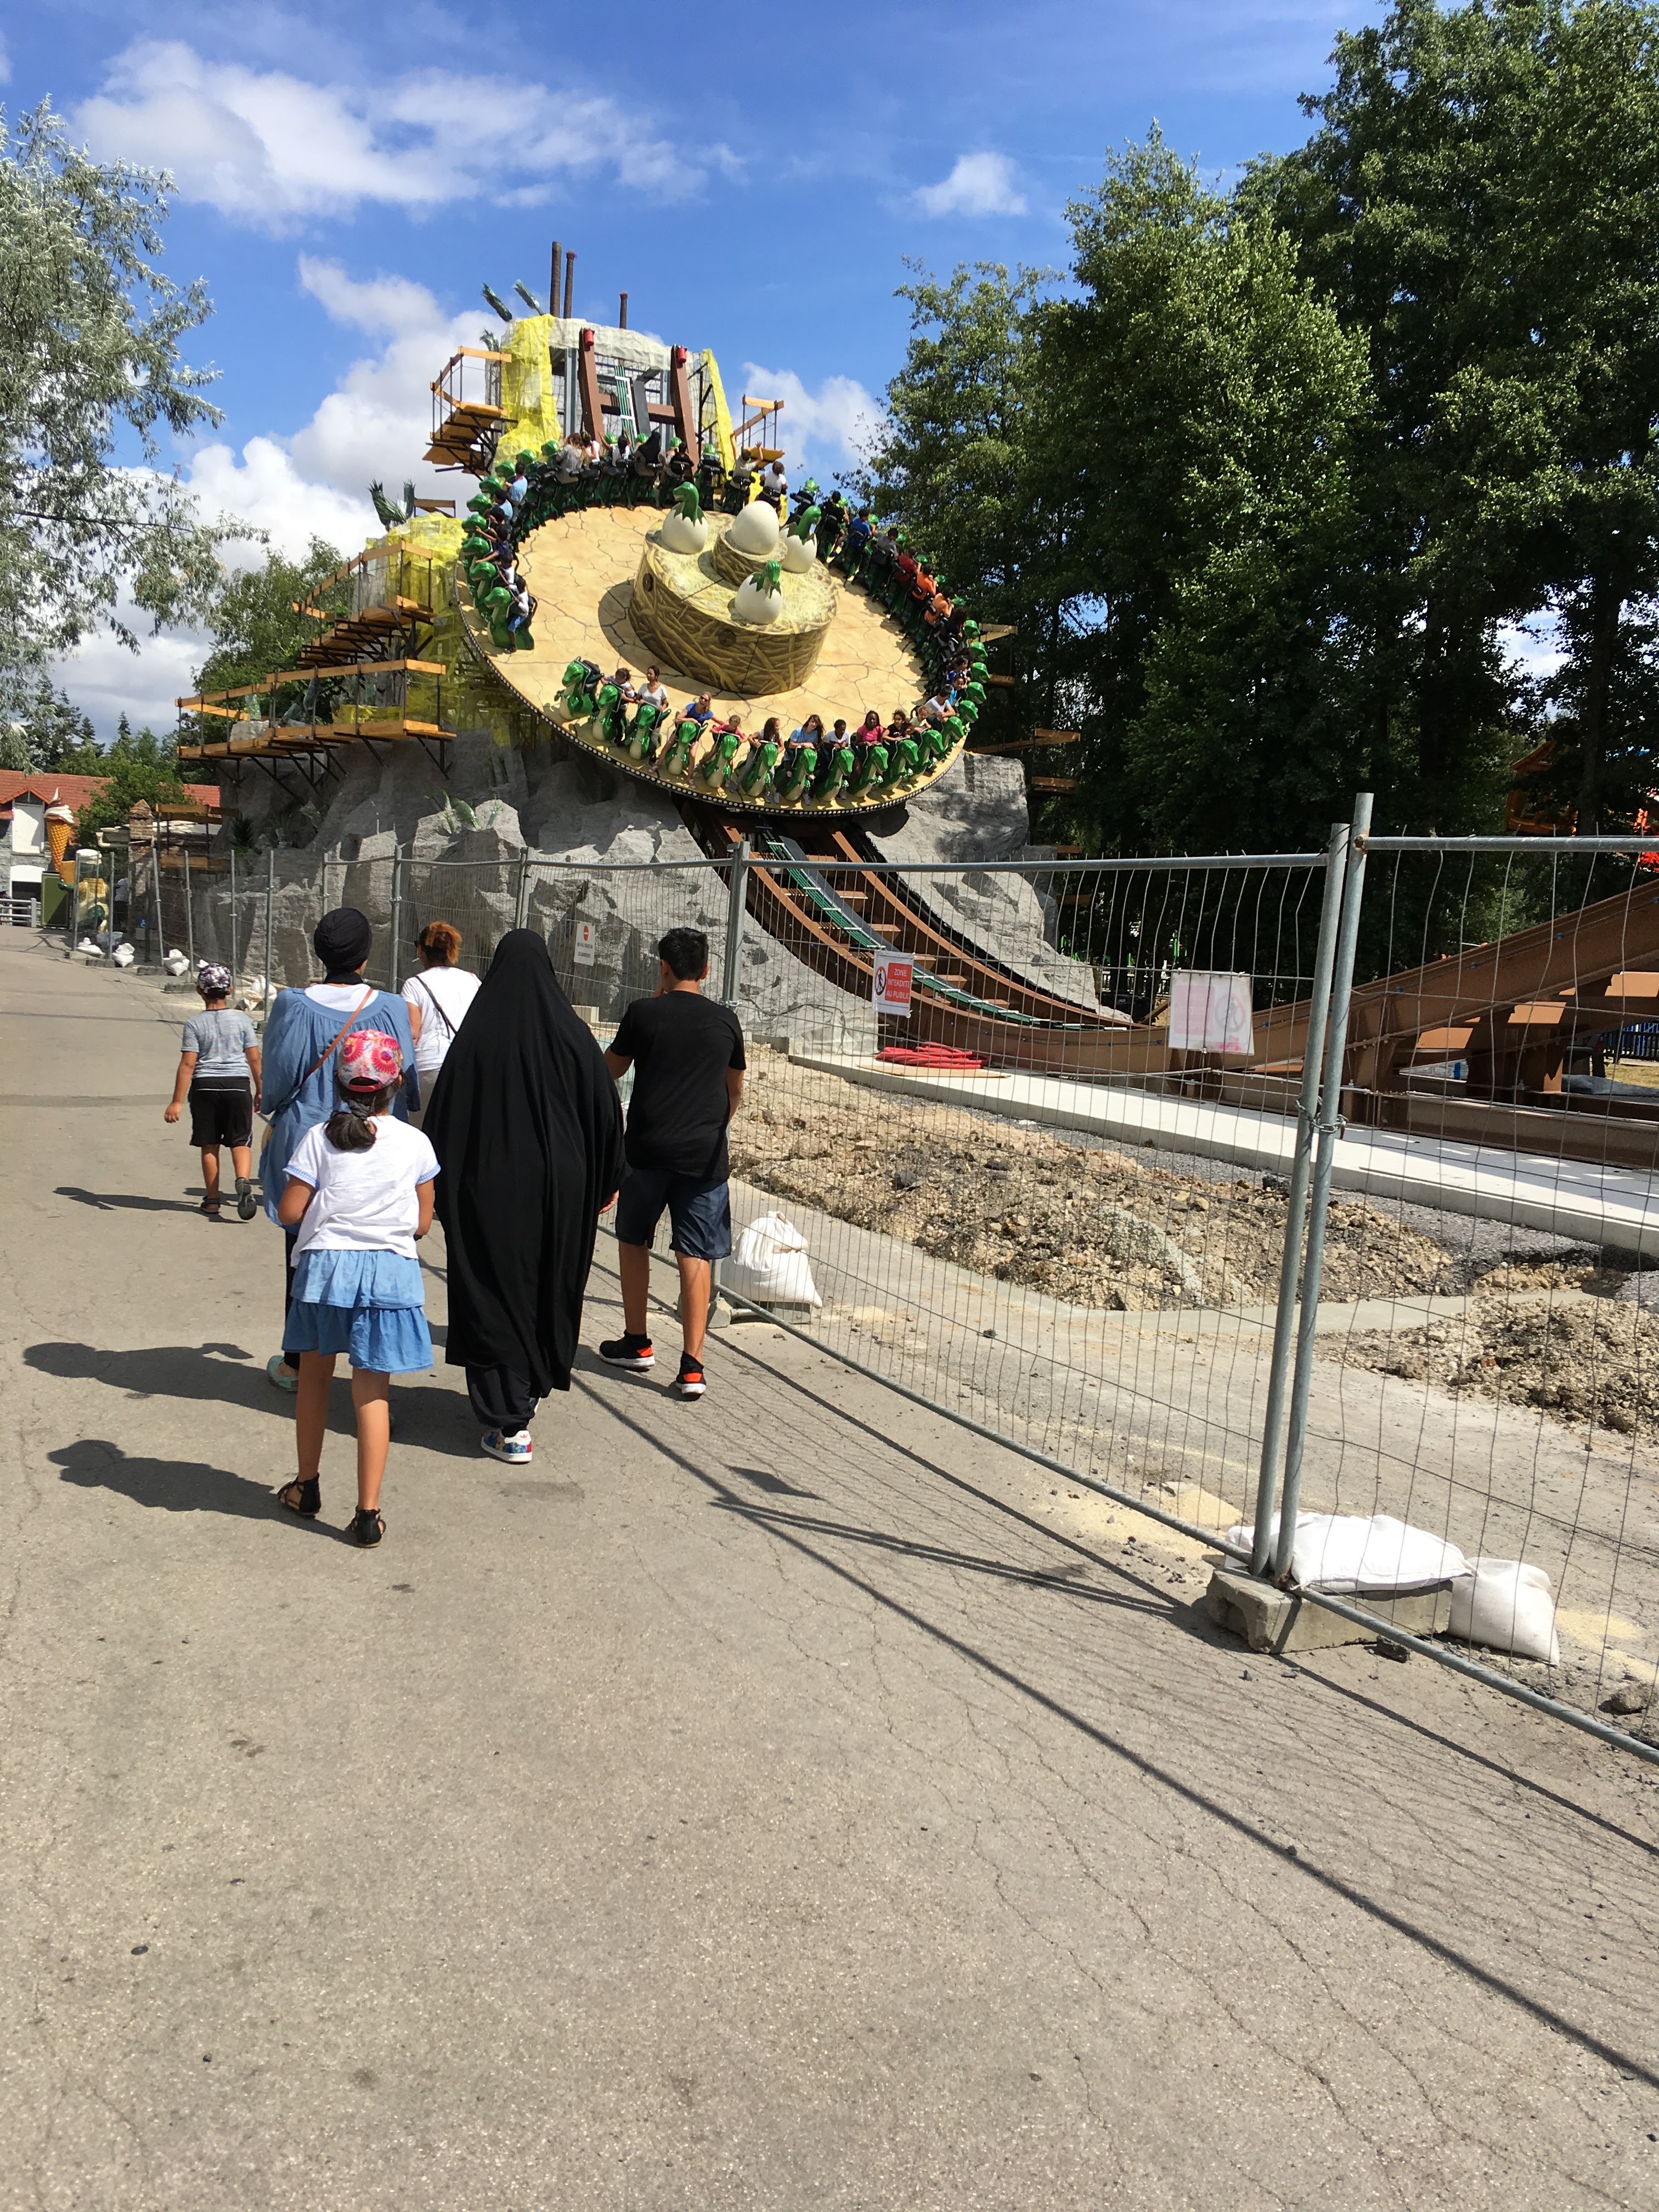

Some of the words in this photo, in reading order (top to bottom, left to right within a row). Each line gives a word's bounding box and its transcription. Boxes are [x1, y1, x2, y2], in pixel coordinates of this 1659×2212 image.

[894, 968, 907, 977] ZONE
[888, 979, 910, 988] INTERDITE
[893, 991, 909, 1000] PUBLIC
